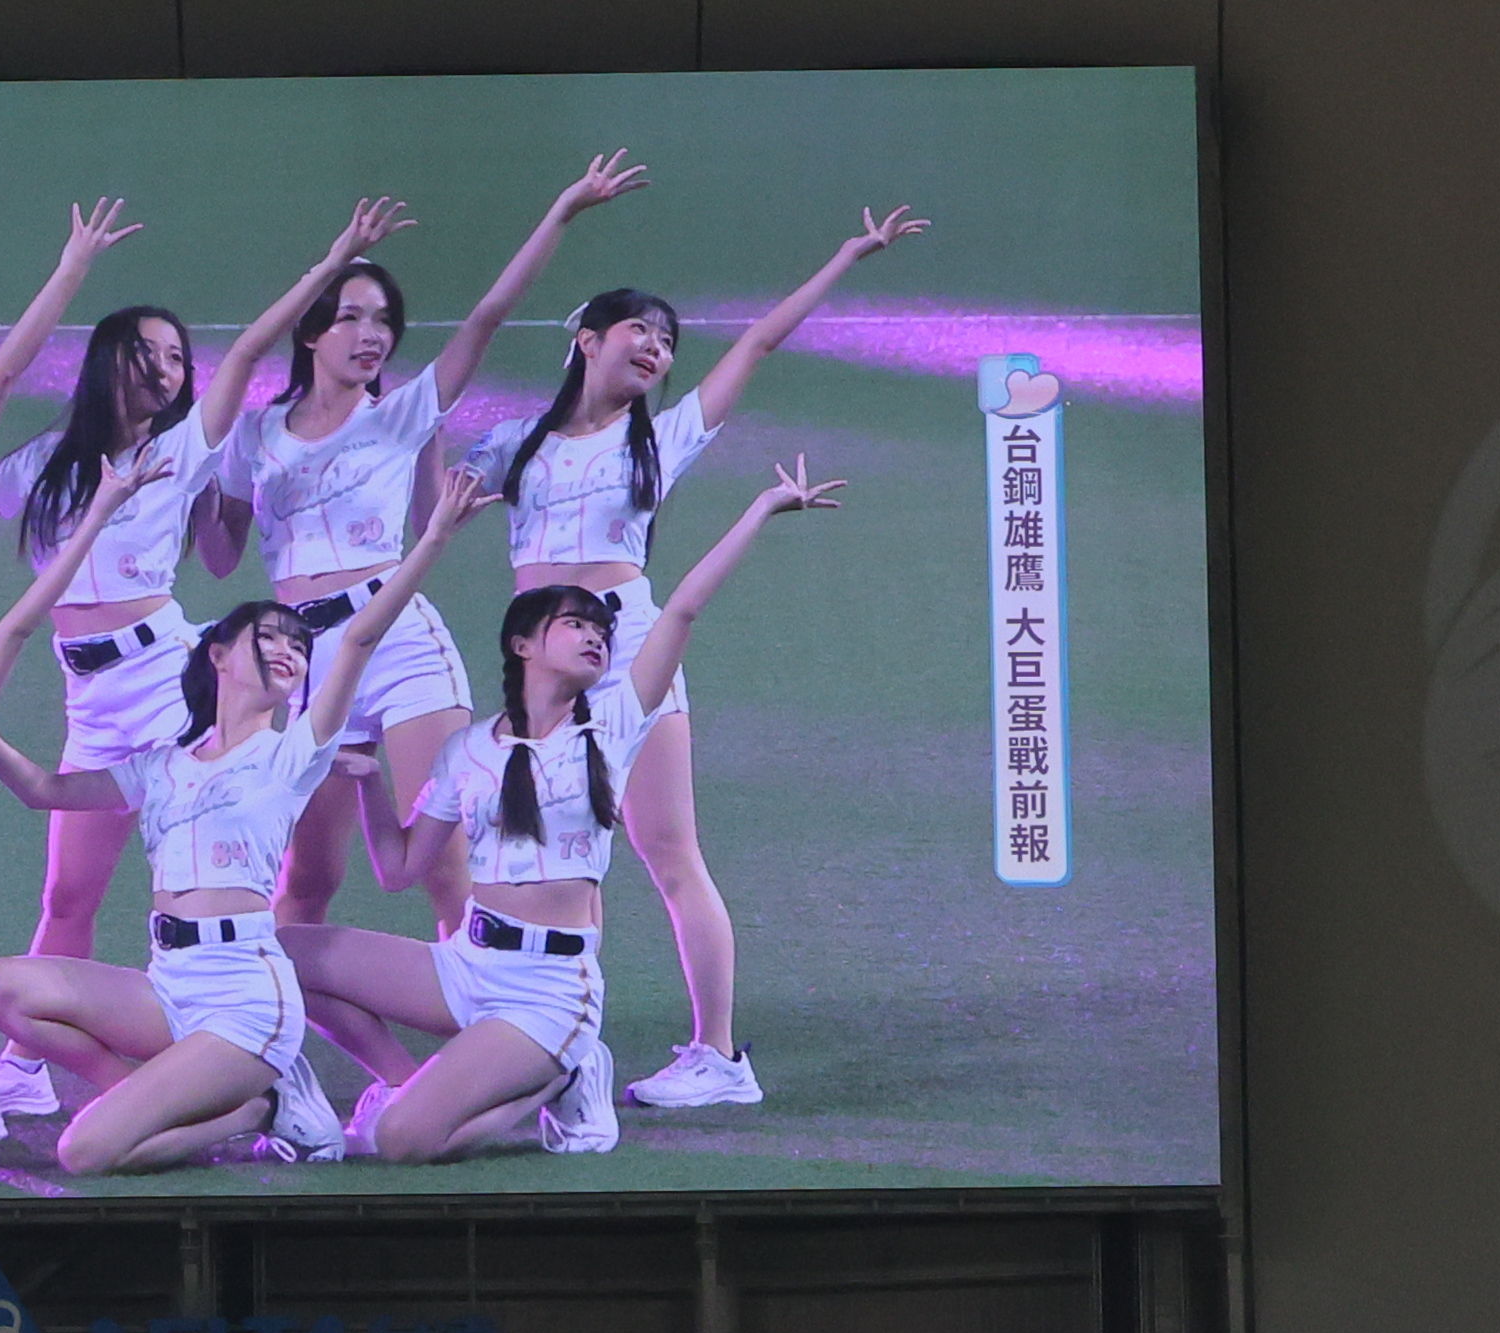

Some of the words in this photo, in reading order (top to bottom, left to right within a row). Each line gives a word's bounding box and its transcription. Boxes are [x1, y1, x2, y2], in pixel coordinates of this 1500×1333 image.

[1002, 424, 1044, 592] 台鋼雄鷹
[1005, 607, 1050, 863] 大巨蛋戰前報
